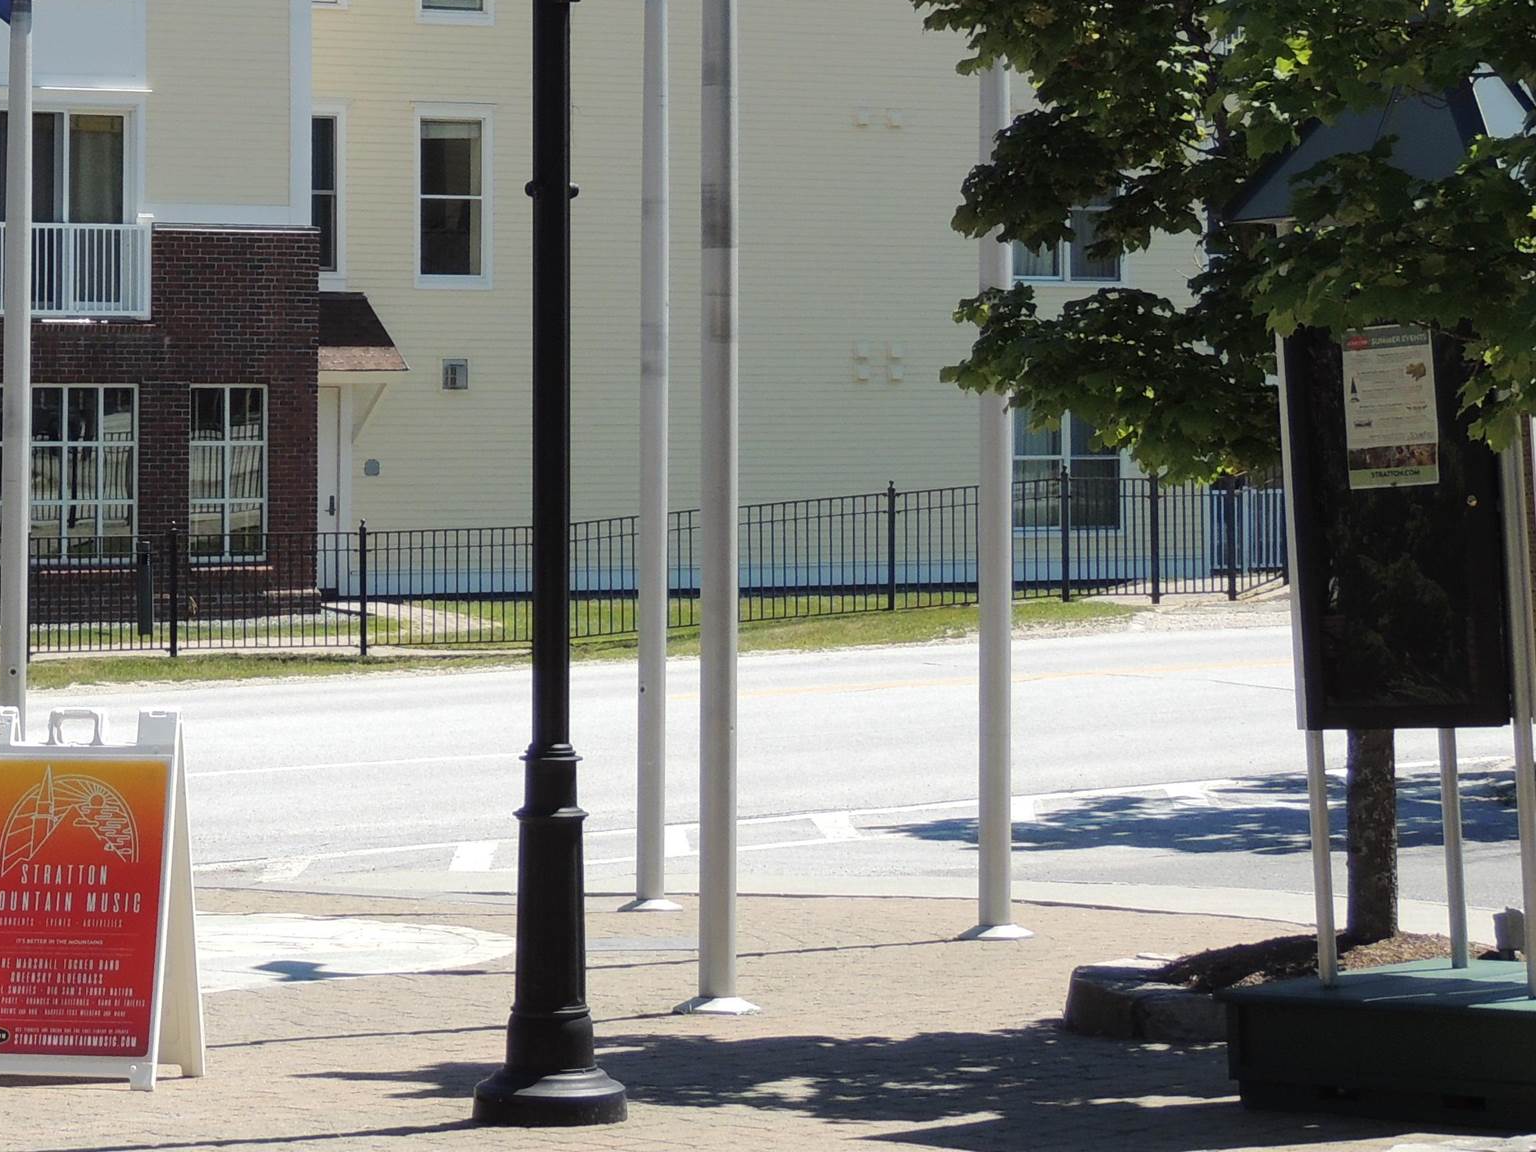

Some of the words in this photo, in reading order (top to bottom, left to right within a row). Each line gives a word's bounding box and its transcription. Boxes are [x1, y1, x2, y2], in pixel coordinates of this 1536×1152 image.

[21, 864, 107, 885] STRATTON
[86, 892, 142, 913] MUSIC
[16, 958, 57, 970] MARSHALL
[64, 959, 93, 970] TUCKER
[98, 959, 120, 970] BAND
